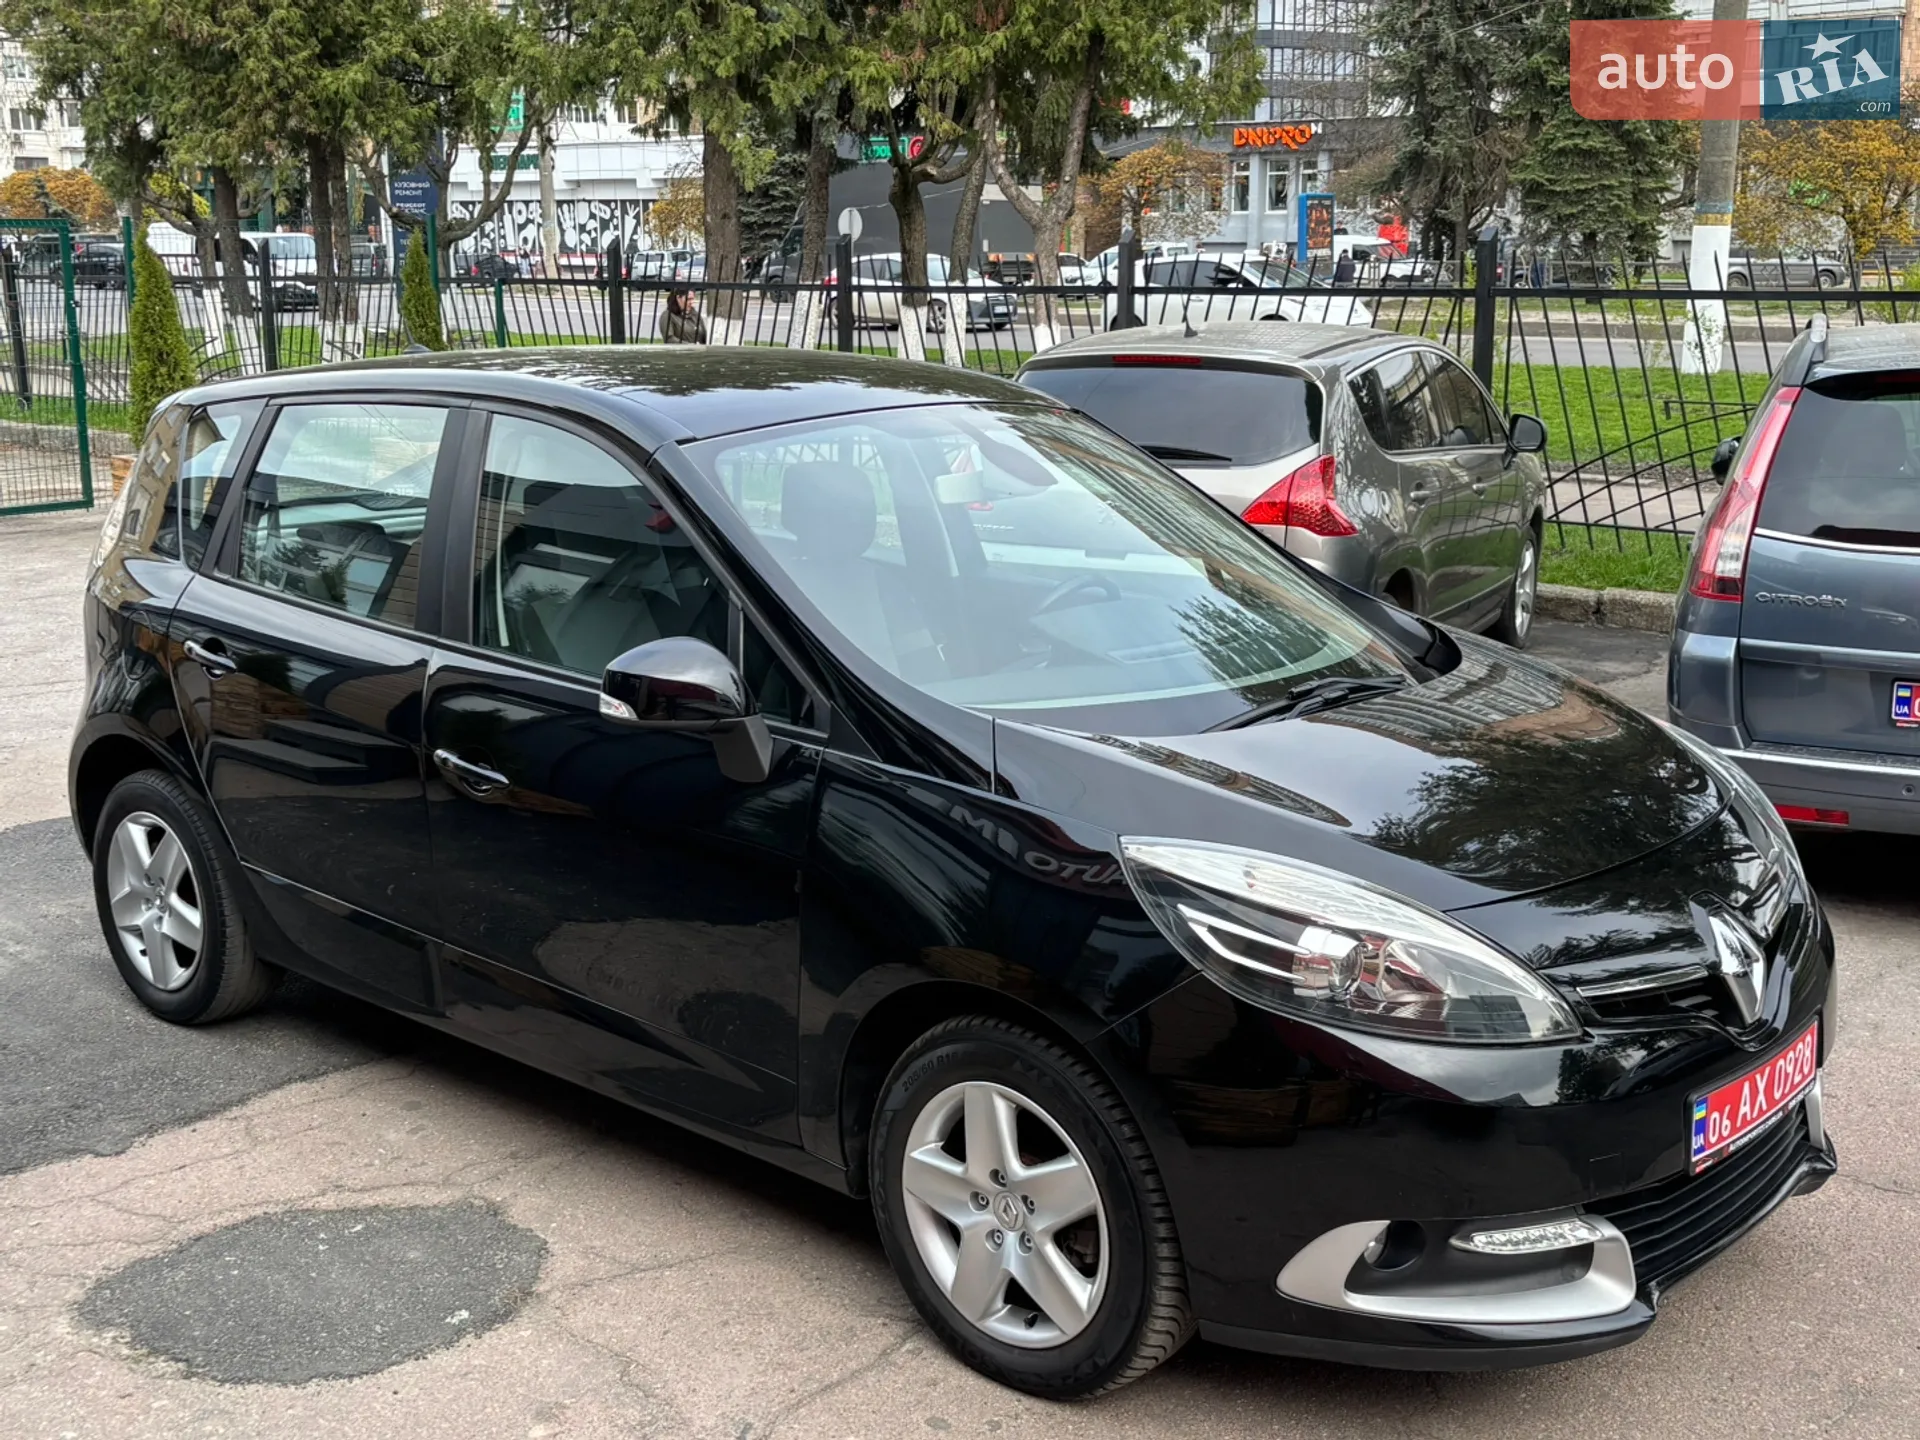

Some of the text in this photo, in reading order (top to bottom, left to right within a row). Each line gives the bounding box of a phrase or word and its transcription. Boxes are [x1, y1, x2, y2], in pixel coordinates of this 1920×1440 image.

[1233, 124, 1312, 150] DNIPRO
[1755, 591, 1848, 608] CITROËN
[1895, 704, 1909, 715] UA
[1708, 1104, 1732, 1144] 06
[1736, 1066, 1771, 1128] AX
[1773, 1034, 1812, 1100] 0928
[1692, 1133, 1705, 1150] UA
